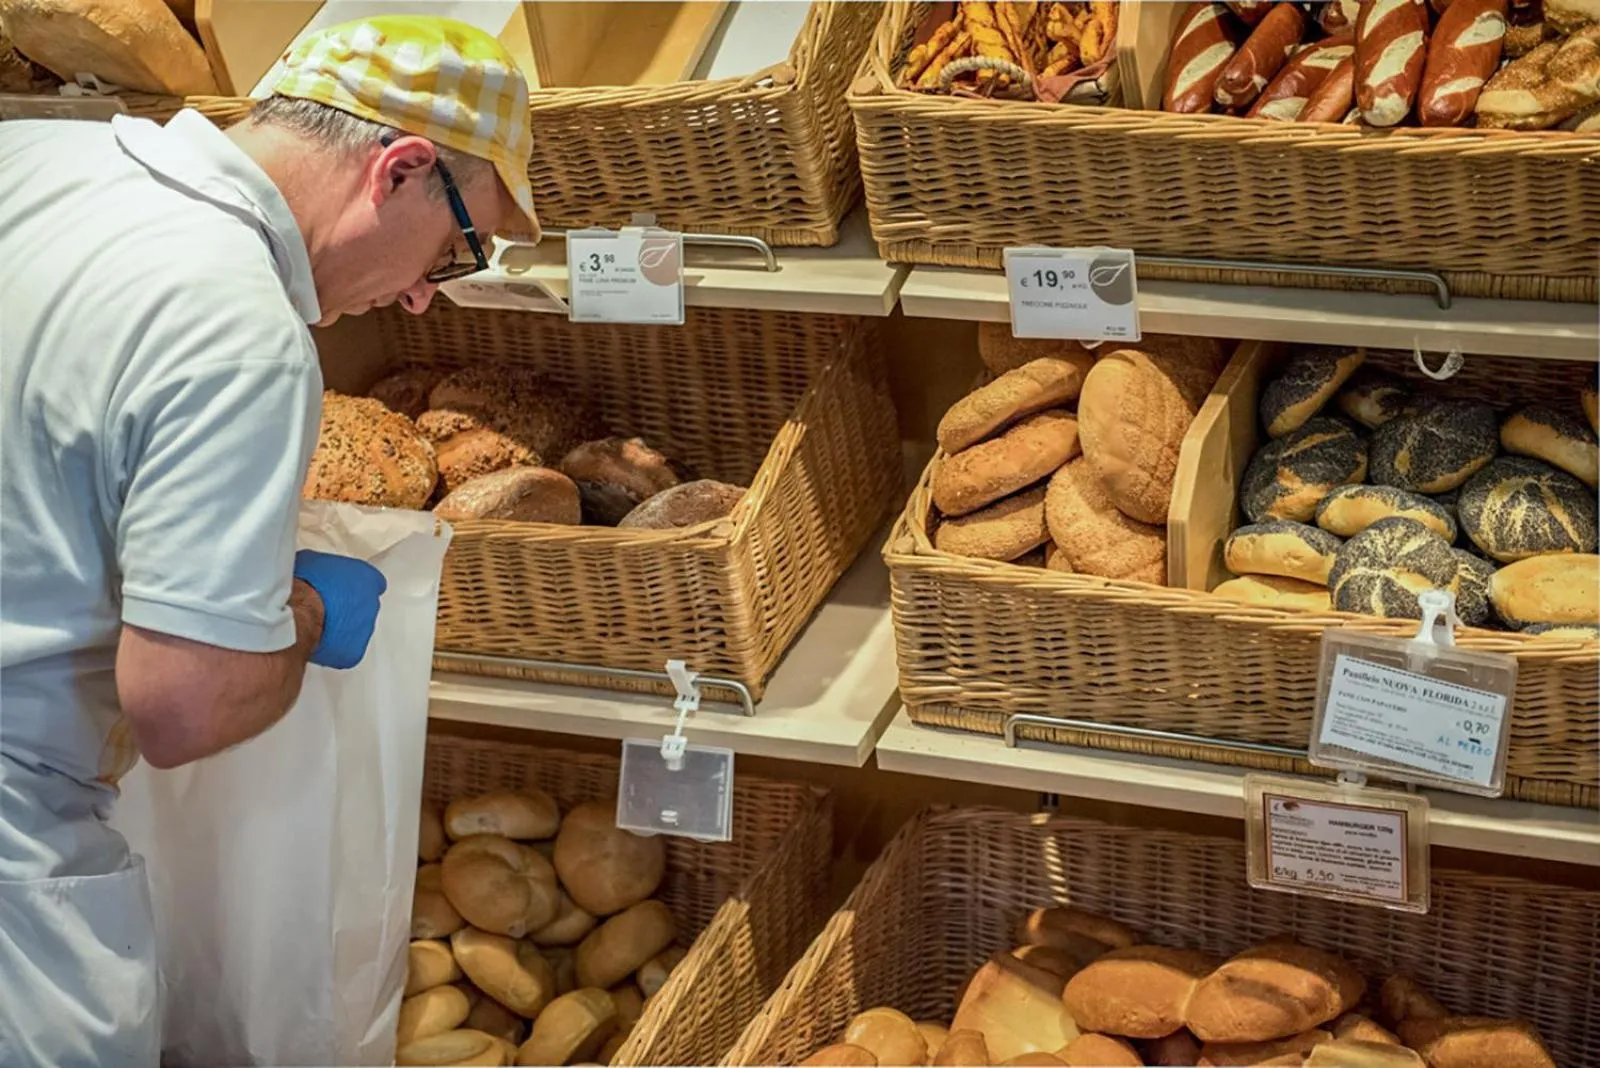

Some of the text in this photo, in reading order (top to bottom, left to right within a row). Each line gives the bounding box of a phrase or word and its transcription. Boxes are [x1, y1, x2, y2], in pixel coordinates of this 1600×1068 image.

[579, 262, 587, 273] €
[1021, 269, 1075, 291] € 19,90
[1342, 668, 1380, 684] Panificio
[1381, 677, 1417, 694] NUOVA
[1422, 688, 1468, 707] FLORIDA
[1471, 700, 1478, 709] 2
[1462, 718, 1490, 738] 0,70
[1328, 819, 1375, 831] HAMBURGER
